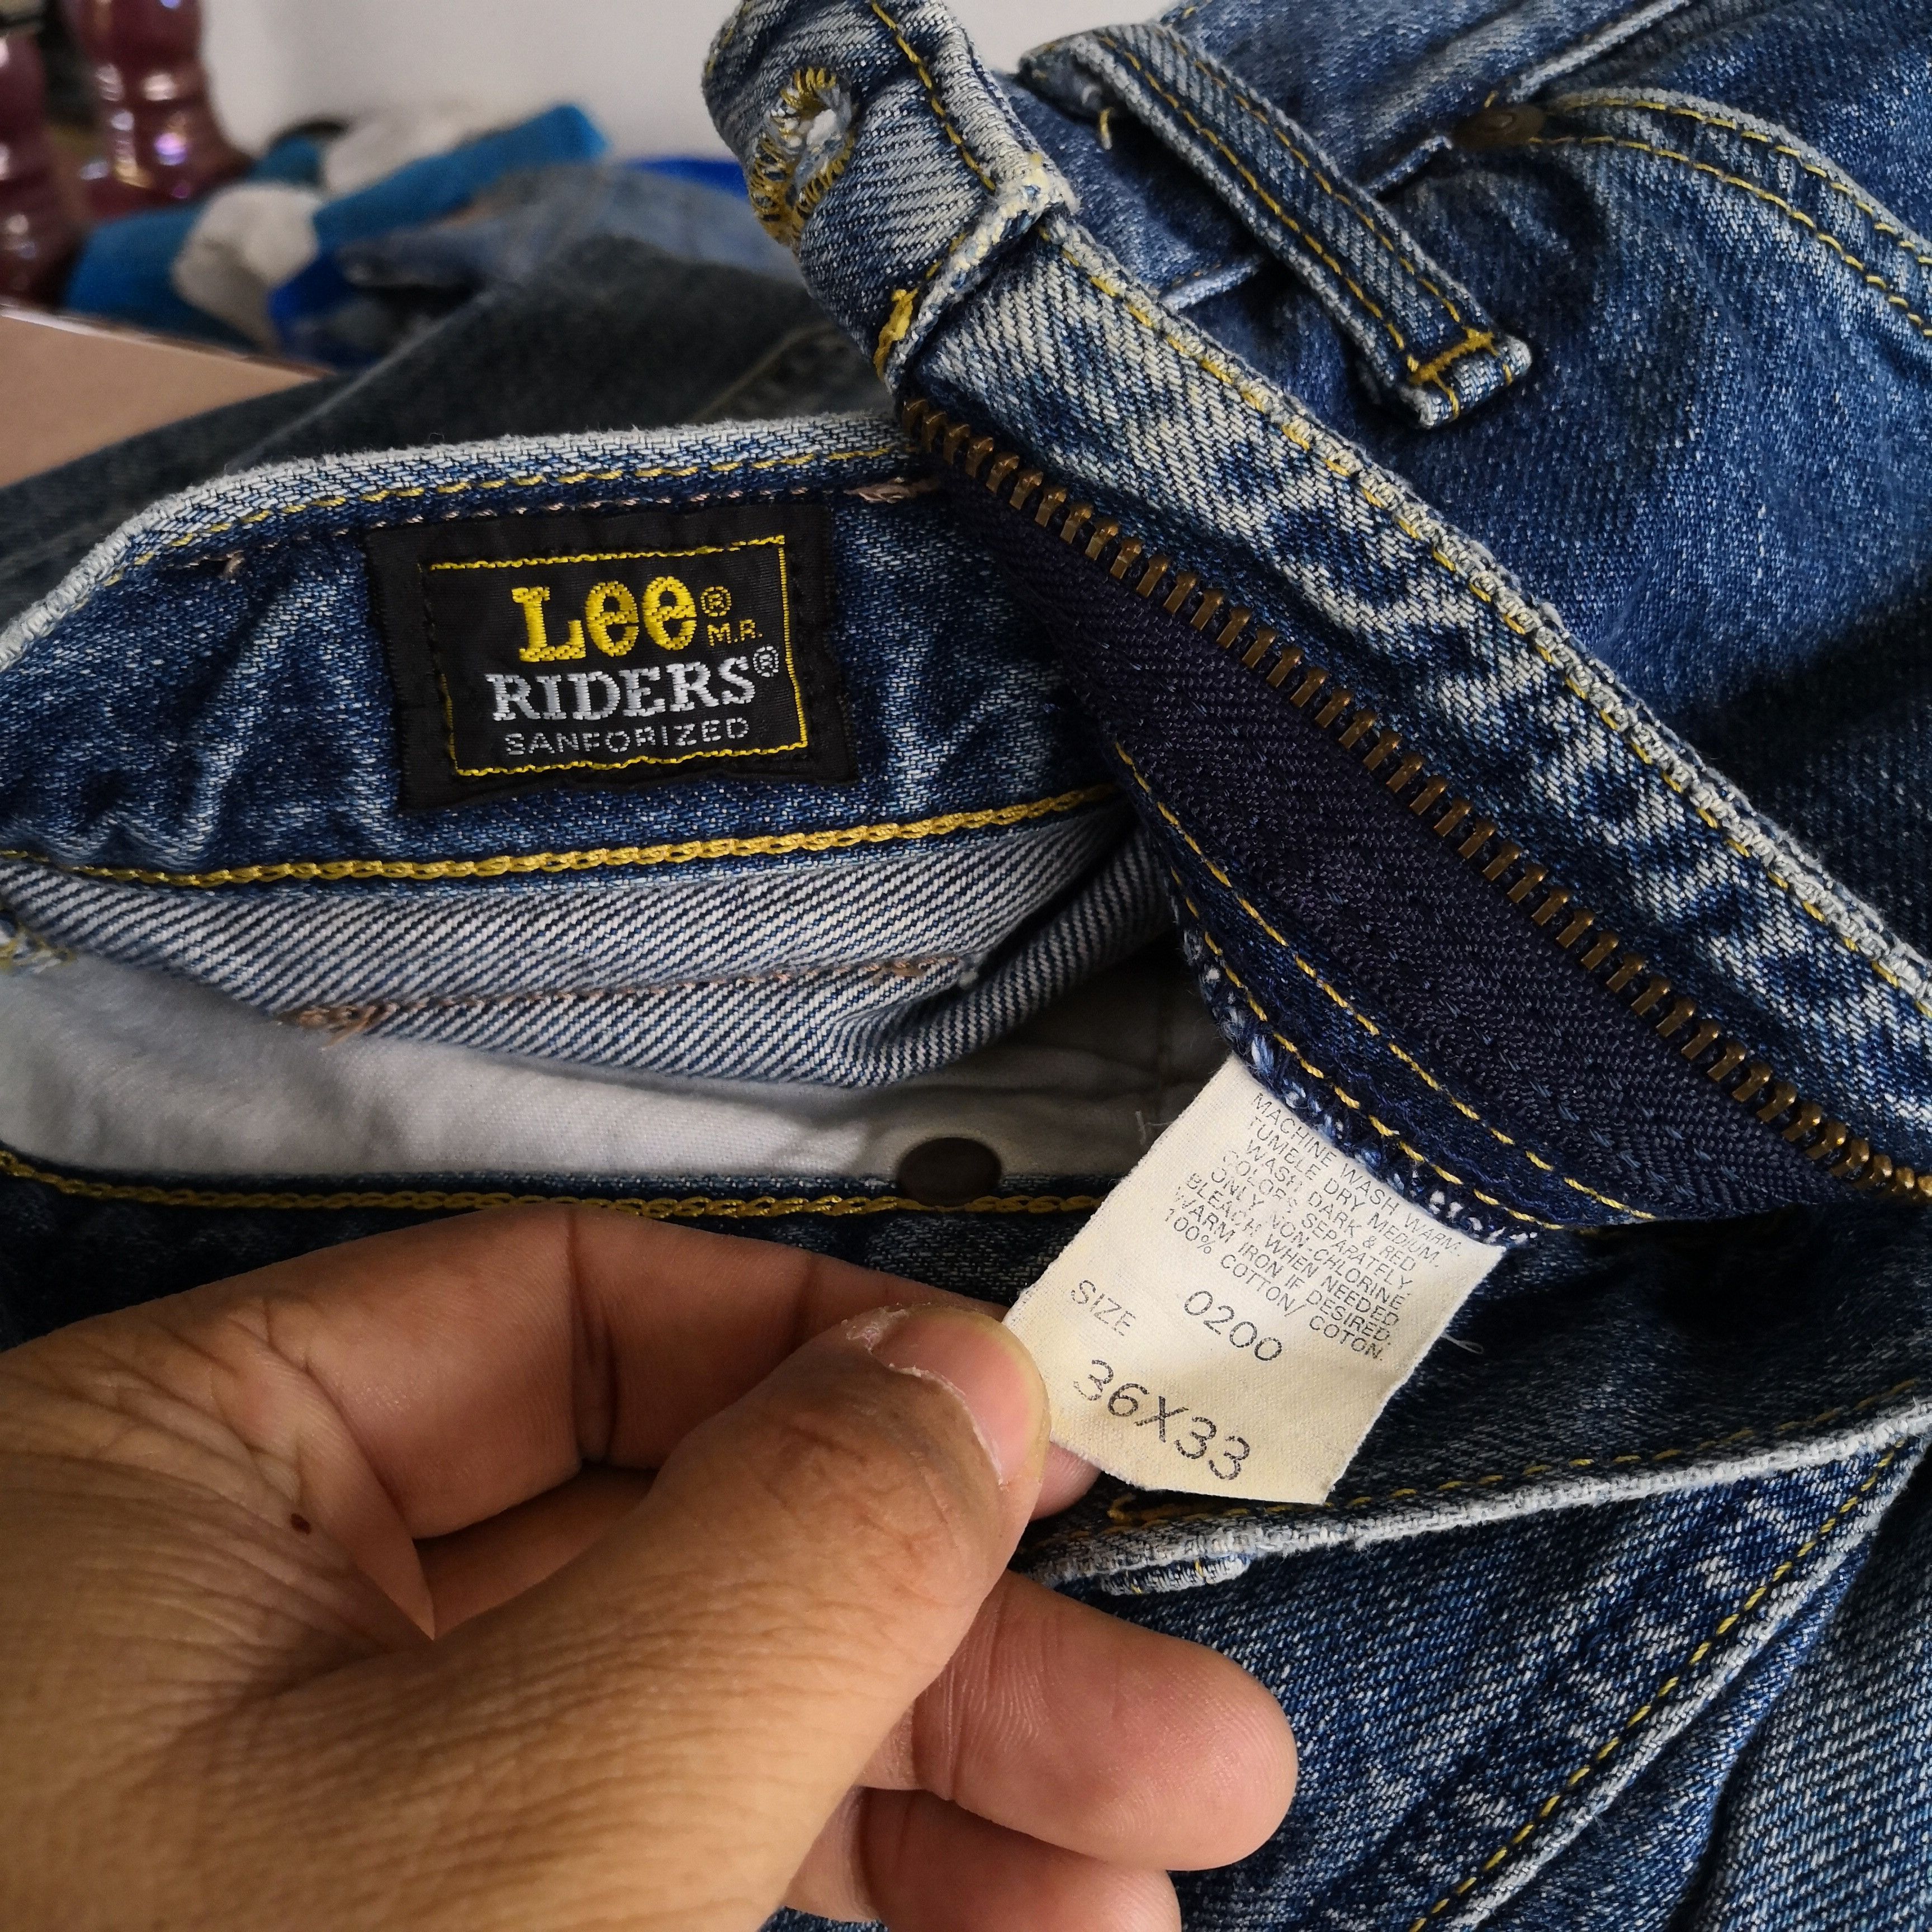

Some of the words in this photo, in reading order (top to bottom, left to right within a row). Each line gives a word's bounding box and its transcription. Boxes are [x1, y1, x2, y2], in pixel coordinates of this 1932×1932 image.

[504, 717, 750, 756] SANFORIZED
[1246, 1139, 1303, 1192] WASH
[1308, 1191, 1362, 1238] DARK
[1361, 1234, 1377, 1250] &
[1379, 1244, 1418, 1273] RED
[1248, 1115, 1322, 1181] TUMBLE
[1323, 1178, 1366, 1212] DRY
[1367, 1212, 1440, 1267] MEDIUM.
[1251, 1093, 1337, 1167] MACHINE
[1340, 1163, 1399, 1216] WASH
[1165, 1208, 1215, 1254] 100%
[1309, 1315, 1383, 1361] COTON.
[1176, 1186, 1235, 1243] WARM
[1238, 1242, 1284, 1278] IRON
[1284, 1274, 1305, 1290] IF
[1305, 1290, 1391, 1346] DESIRED.
[1185, 1172, 1262, 1237] BLEACH
[1265, 1233, 1319, 1278] WHEN
[1320, 1275, 1400, 1326] NEEDED
[1210, 1167, 1265, 1211] ONLY
[1271, 1213, 1406, 1310] NON-CHLORINE
[1301, 1213, 1413, 1296] SEPARATELY.
[1071, 1280, 1136, 1336] SIZE
[1183, 1290, 1283, 1362] 0200
[1073, 1359, 1251, 1480] 36X33
